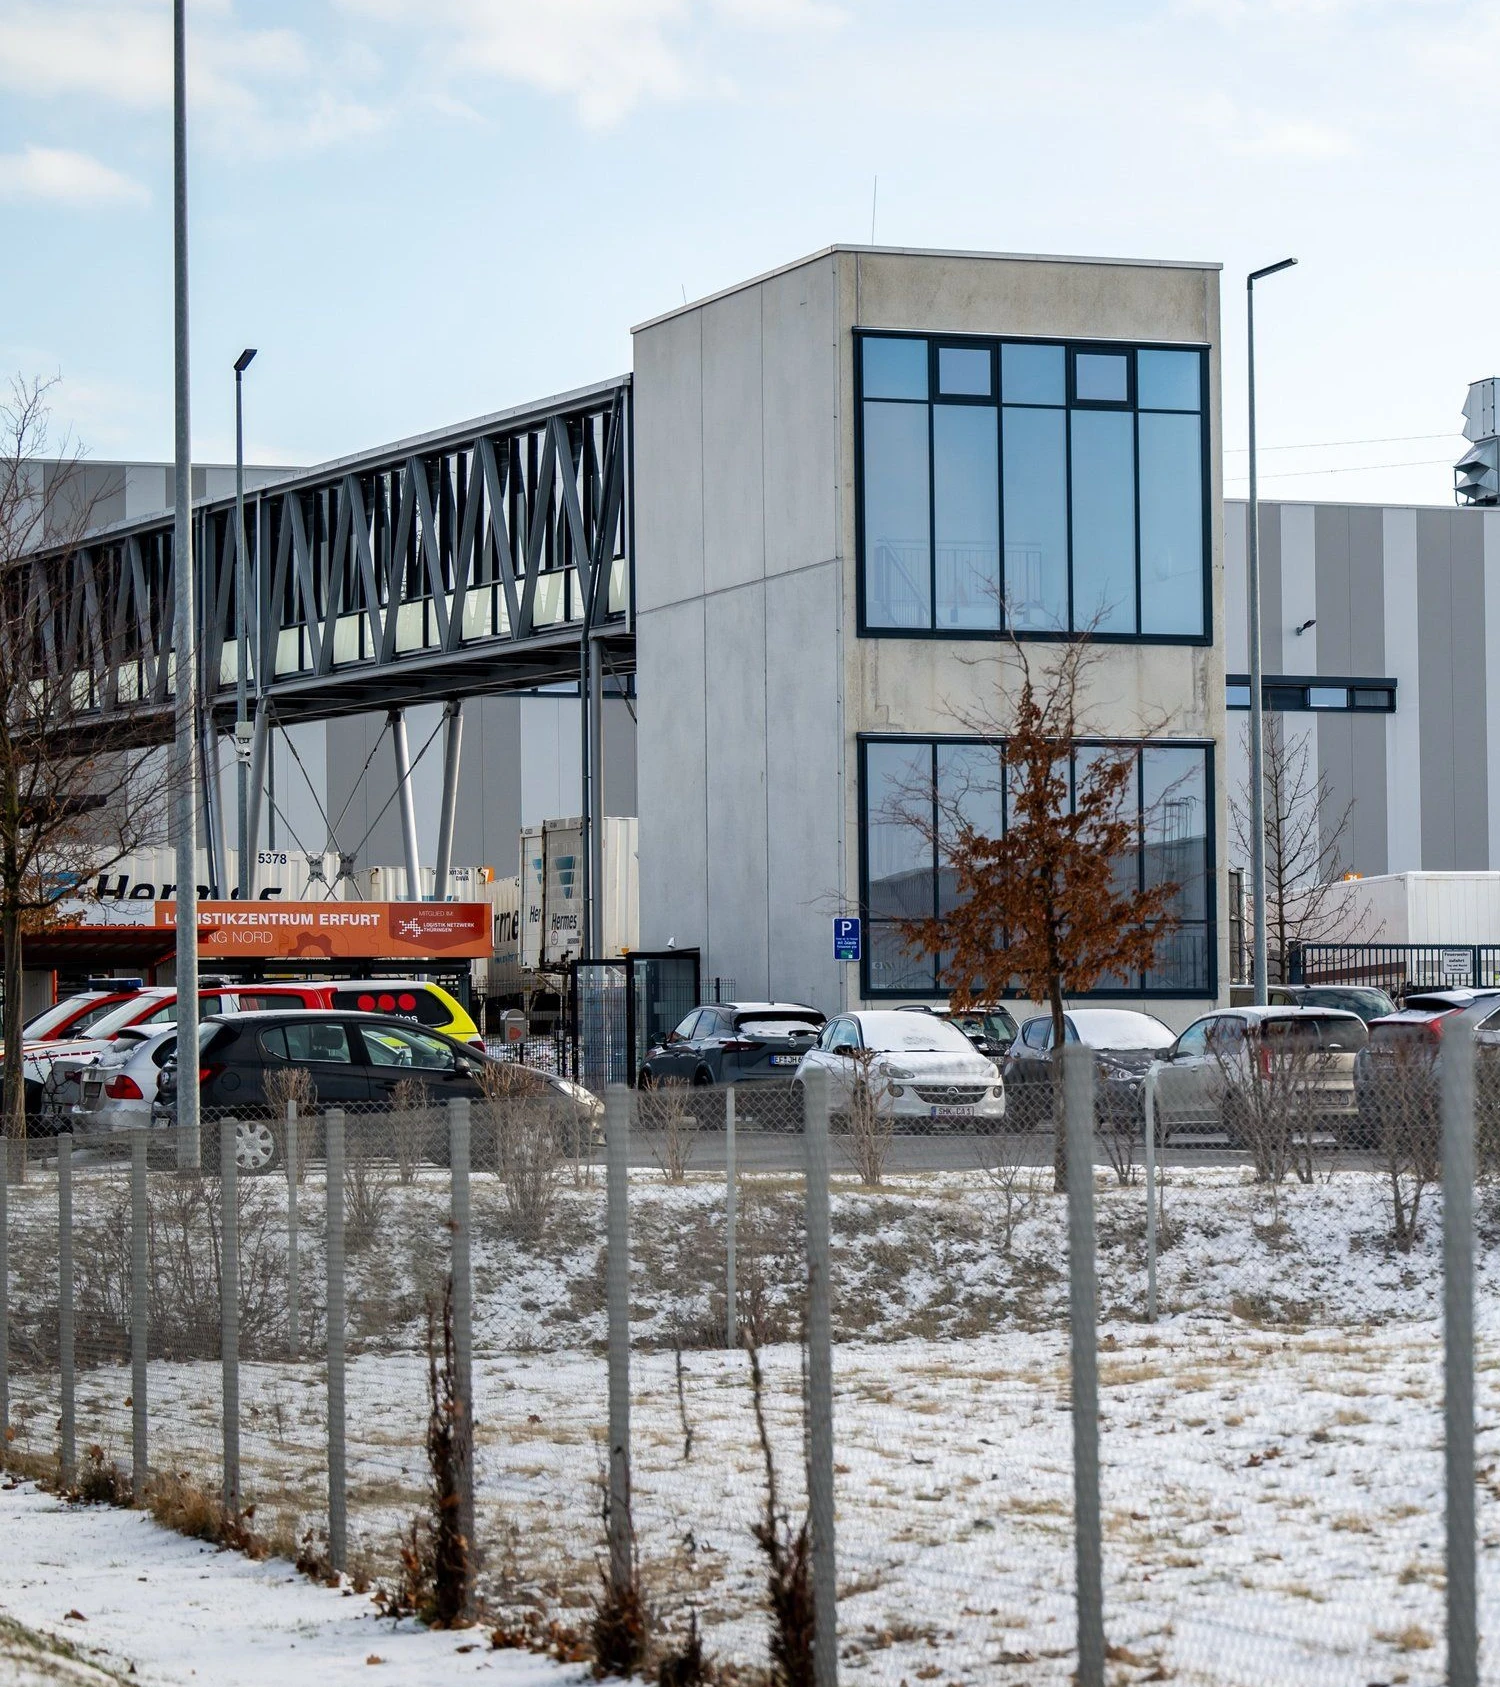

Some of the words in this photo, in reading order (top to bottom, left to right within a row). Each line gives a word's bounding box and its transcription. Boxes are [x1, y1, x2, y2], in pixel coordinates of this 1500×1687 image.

[258, 853, 287, 865] 5378
[165, 912, 314, 926] LISTIKZENTRUM
[319, 913, 381, 926] ERFURT
[551, 912, 578, 931] Hermes
[841, 920, 853, 937] P
[232, 930, 273, 944] NORD
